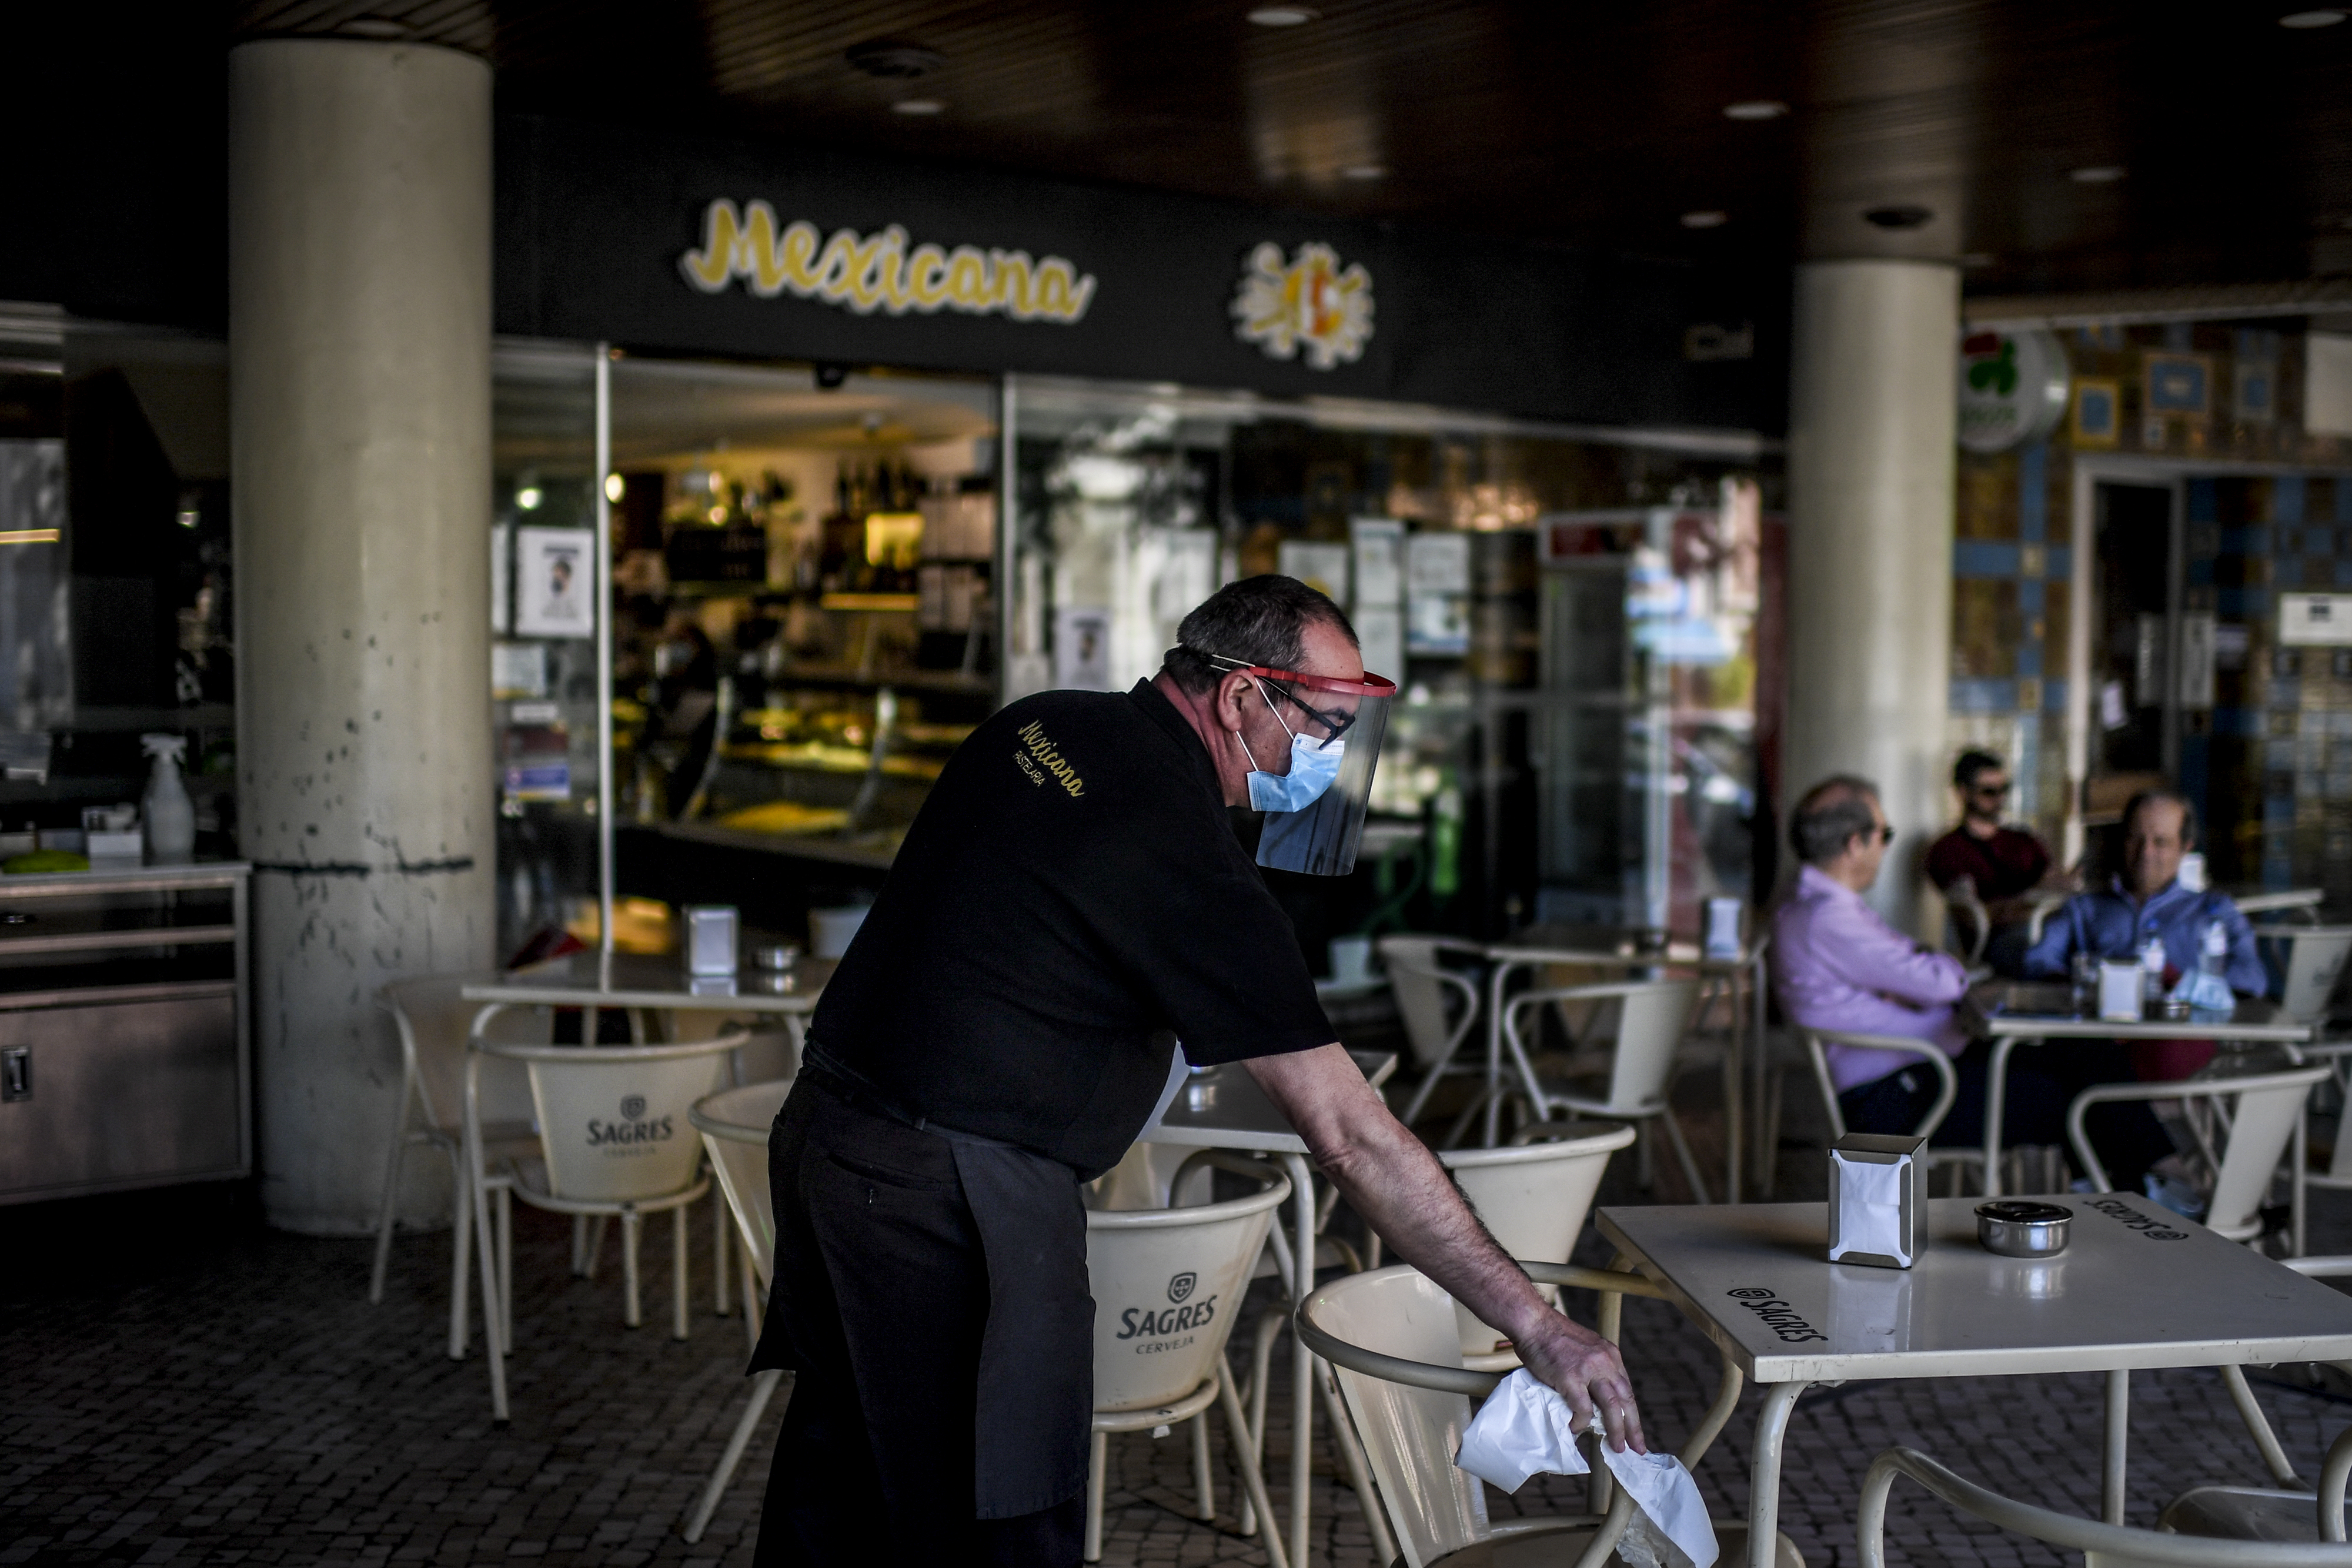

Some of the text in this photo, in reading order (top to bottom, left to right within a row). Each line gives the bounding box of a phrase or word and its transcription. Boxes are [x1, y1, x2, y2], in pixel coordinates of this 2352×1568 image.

[682, 199, 1095, 322] Mexicana
[1013, 750, 1045, 787] PASTELARIA
[1018, 720, 1085, 797] Mexicana
[586, 1115, 673, 1145] SAGRES
[1116, 1295, 1218, 1339] SAGRES
[1740, 1300, 1829, 1342] SAGRES
[1136, 1336, 1194, 1355] CERVEJA
